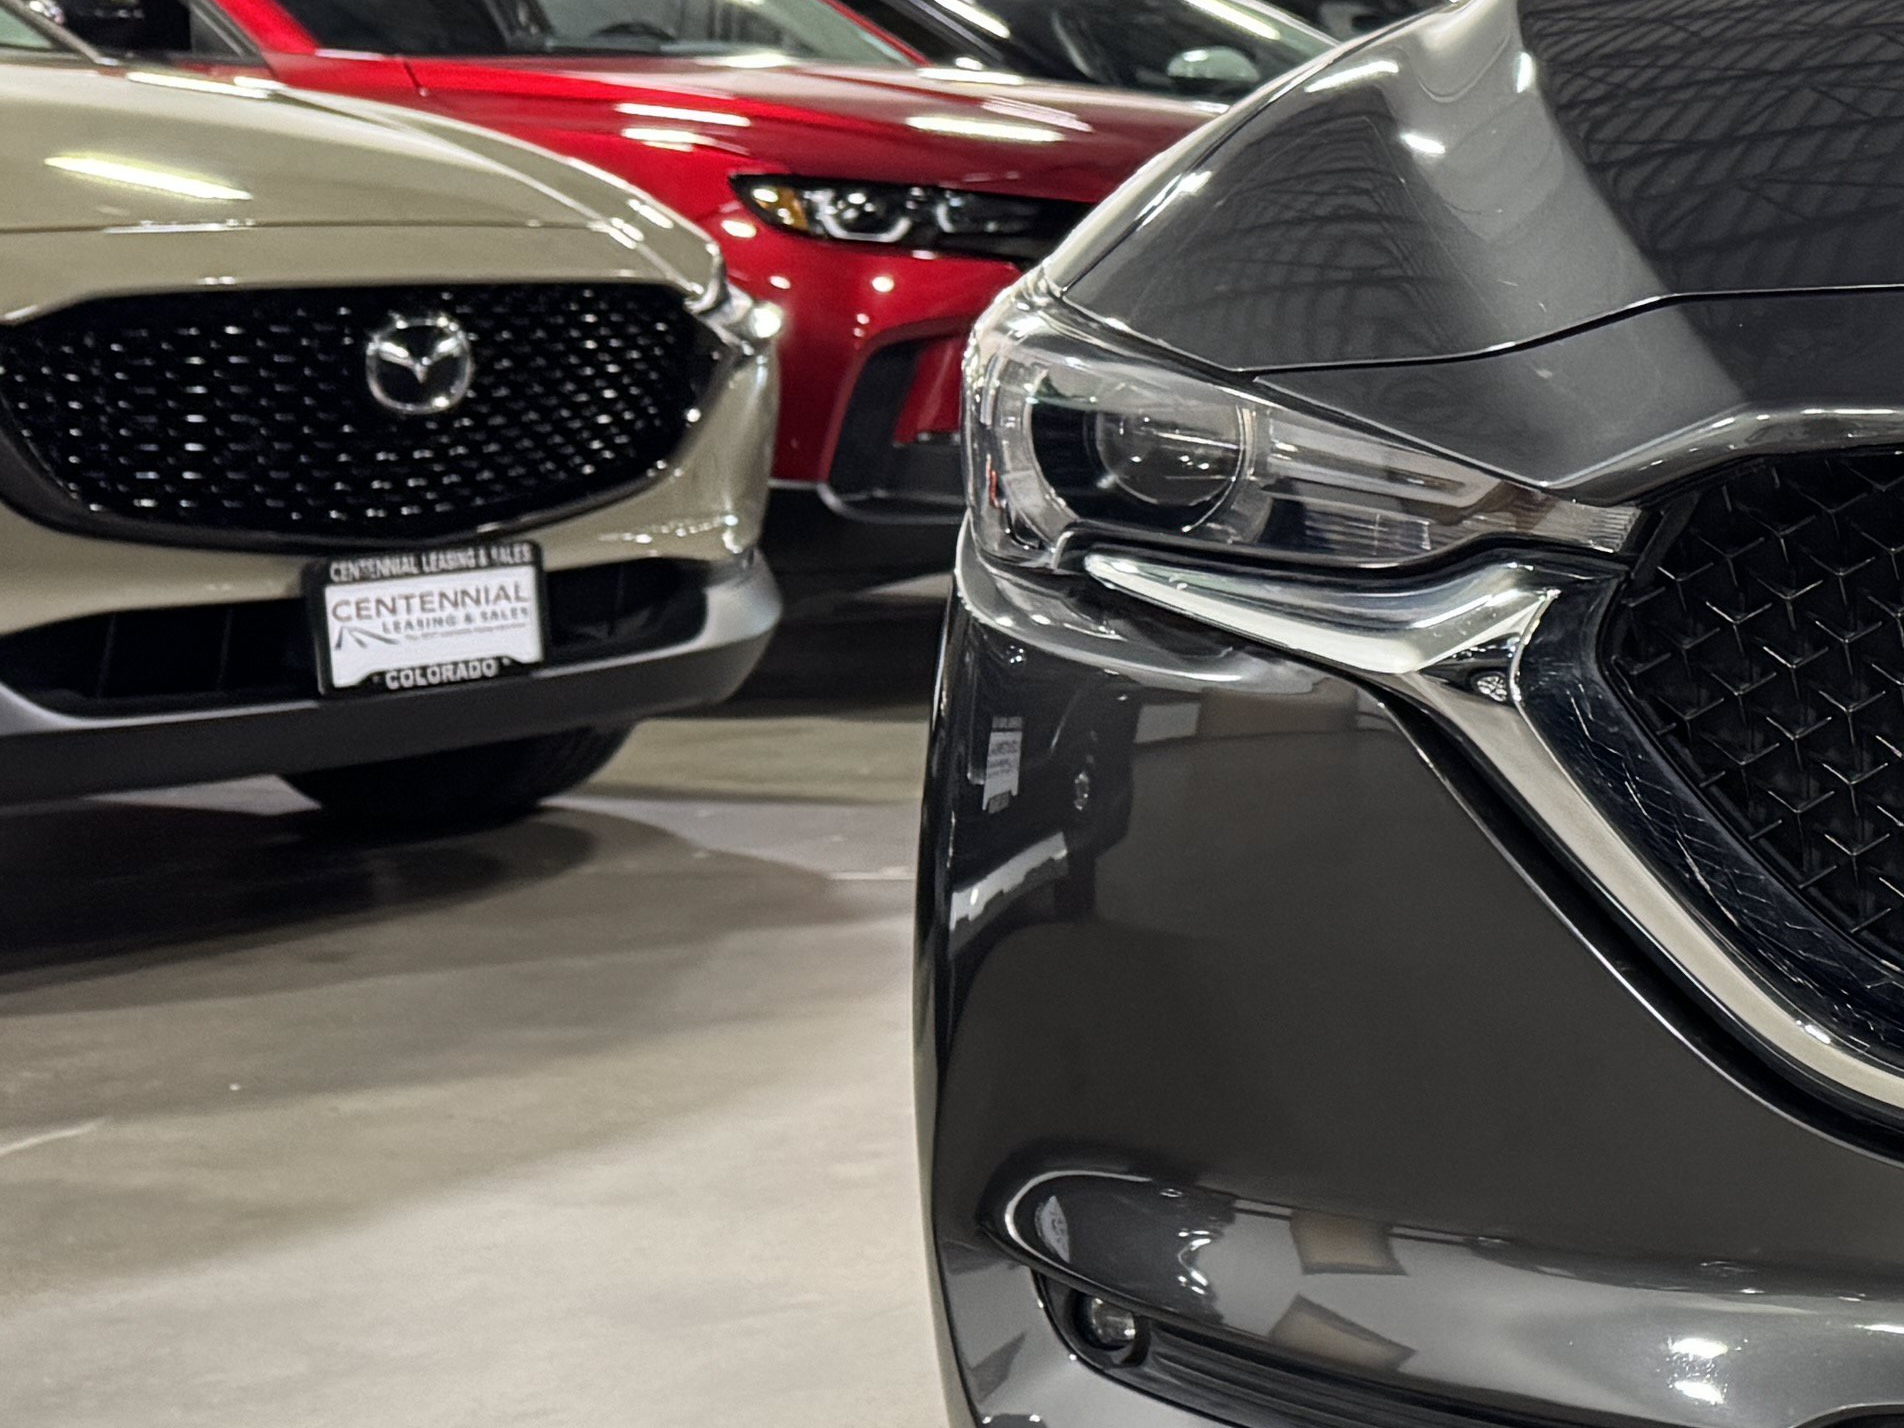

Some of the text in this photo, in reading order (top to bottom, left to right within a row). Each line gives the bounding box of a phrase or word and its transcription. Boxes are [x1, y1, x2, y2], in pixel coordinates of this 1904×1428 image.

[332, 581, 530, 622] CENTENNIAL
[382, 613, 457, 634] LEASING
[480, 607, 529, 622] SALES
[385, 659, 497, 690] COLORADO
